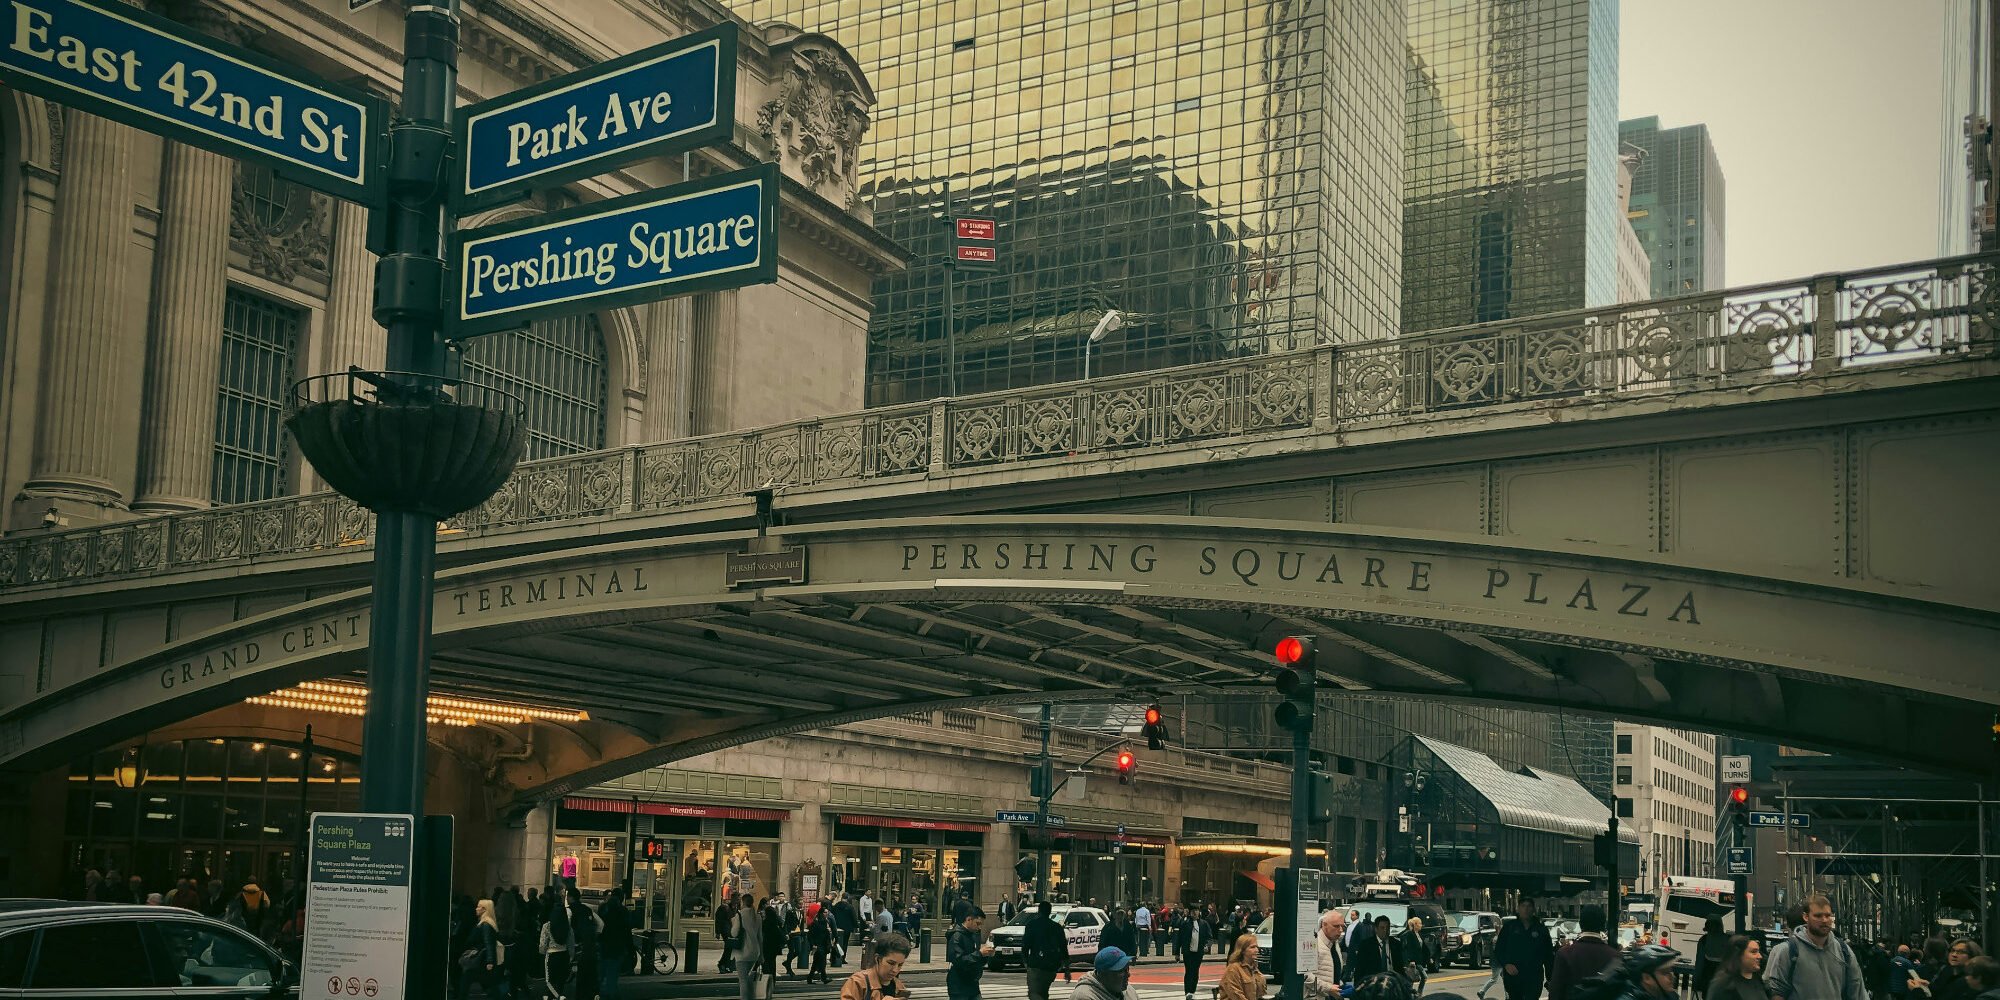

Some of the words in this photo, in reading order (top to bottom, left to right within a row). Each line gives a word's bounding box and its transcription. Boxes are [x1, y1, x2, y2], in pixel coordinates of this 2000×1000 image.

[10, 1, 142, 92] East
[158, 61, 285, 140] 42nd
[300, 107, 349, 162] St
[506, 104, 589, 167] Park
[598, 91, 672, 140] Ave
[469, 236, 618, 299] Pershing
[627, 214, 755, 274] Square
[729, 562, 768, 573] PERSHING
[769, 560, 801, 571] SQUARE
[901, 543, 1158, 573] PERSHING
[1199, 546, 1433, 592] SQUARE
[1482, 567, 1701, 625] PLAZA
[160, 642, 260, 689] GRAND
[282, 614, 361, 653] CENT
[453, 567, 649, 616] TERMINAL
[1729, 761, 1742, 769] NO
[1724, 771, 1749, 779] TURNS
[670, 807, 693, 815] vineyard
[1003, 813, 1017, 821] Park
[1759, 815, 1781, 824] Park
[317, 824, 354, 838] Pershing
[317, 838, 347, 850] Square
[348, 839, 371, 850] Plaza
[1069, 935, 1101, 945] POLICE
